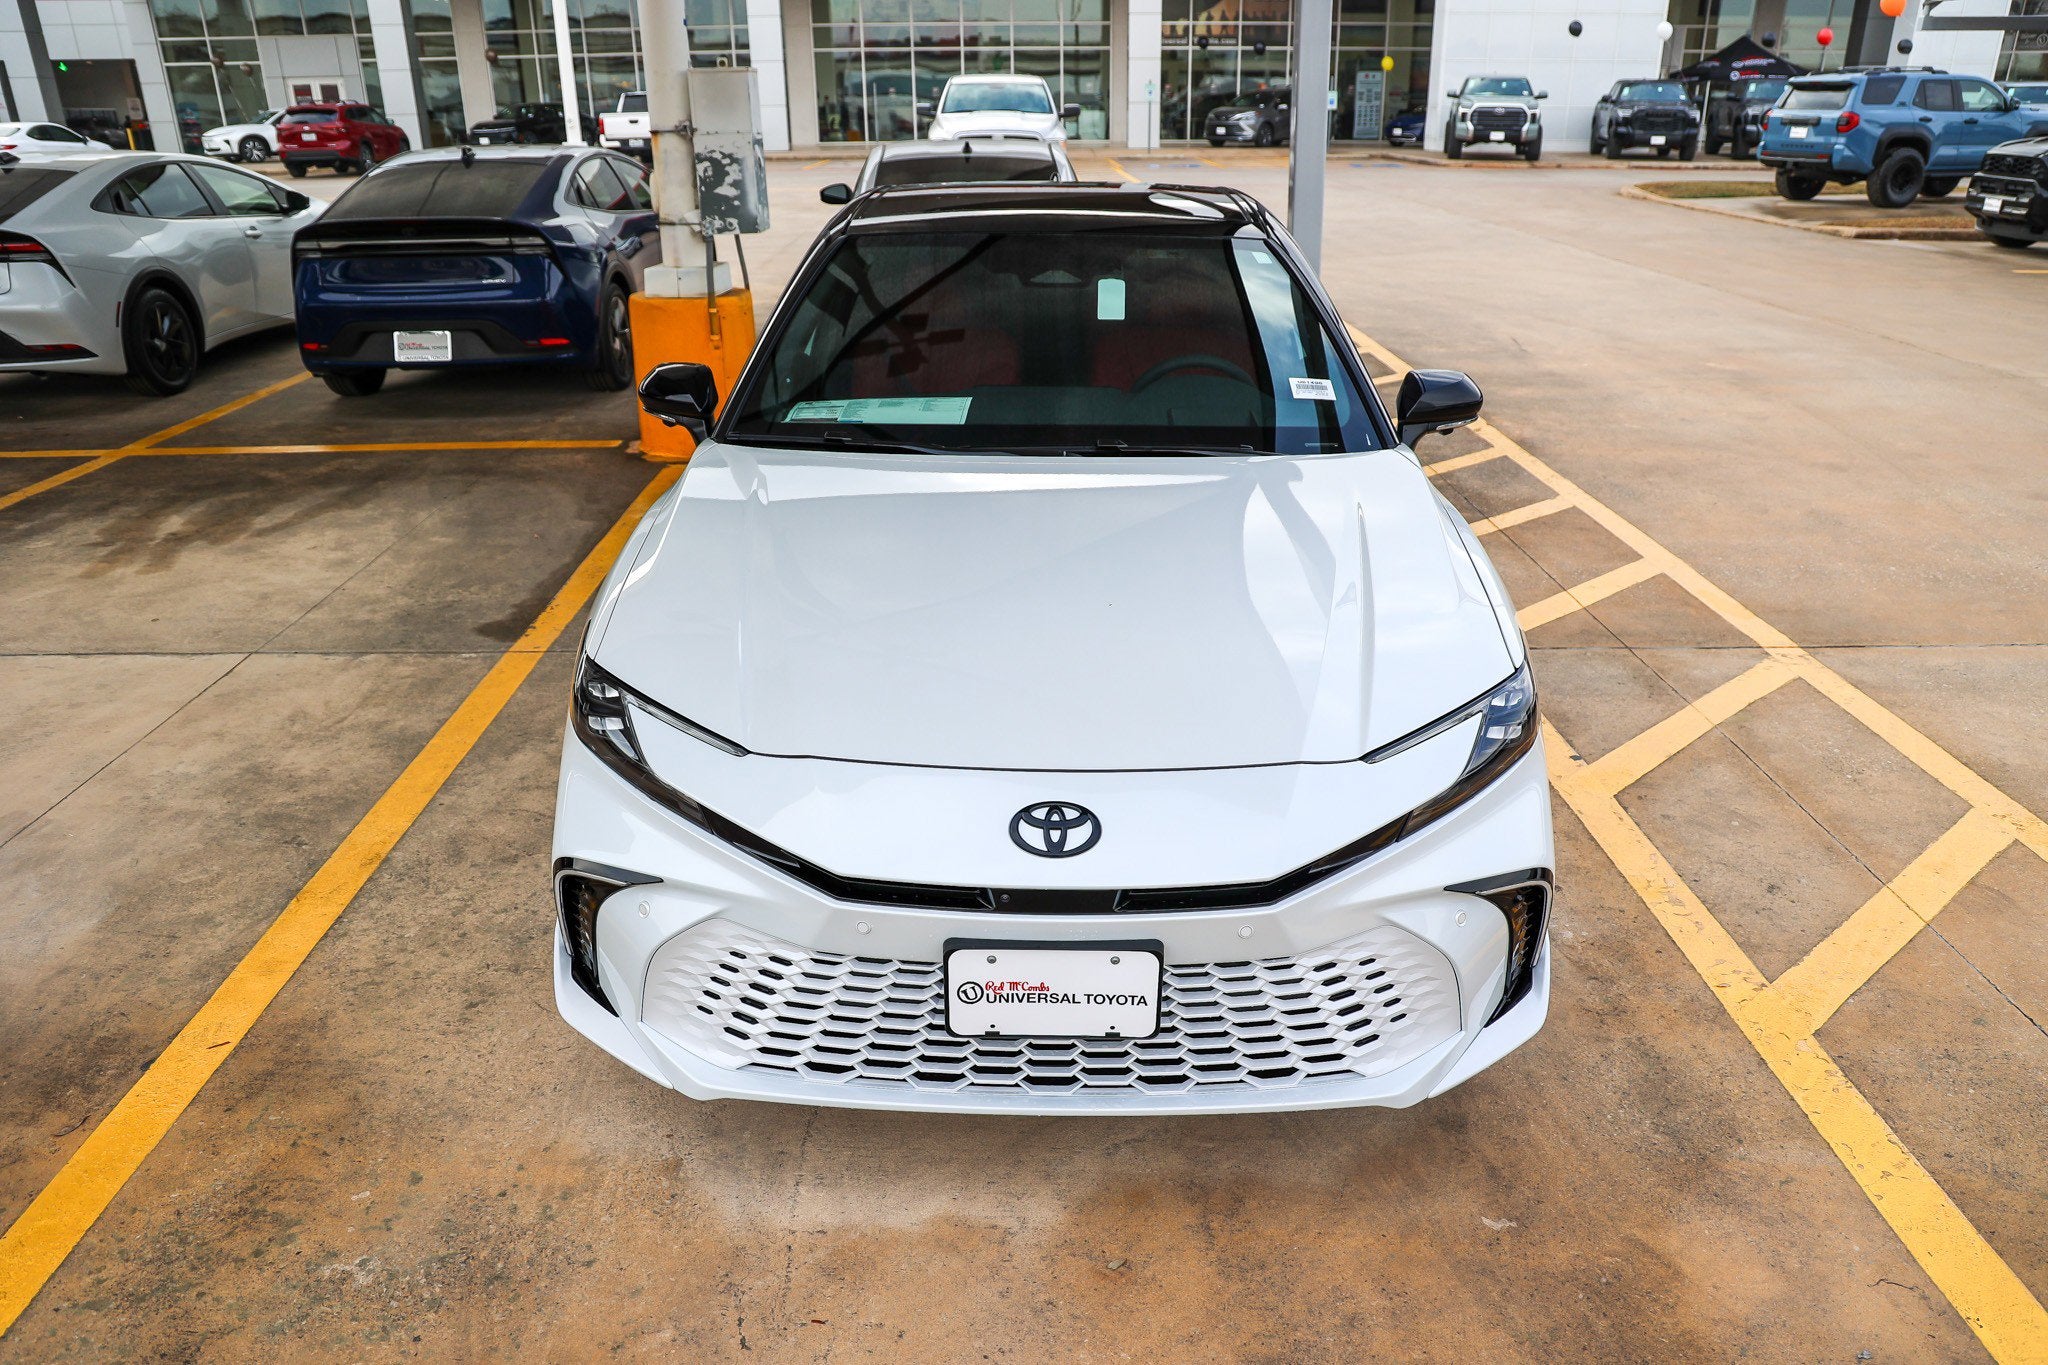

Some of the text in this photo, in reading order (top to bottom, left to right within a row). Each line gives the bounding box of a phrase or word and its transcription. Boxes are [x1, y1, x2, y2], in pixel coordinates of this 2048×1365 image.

[985, 981, 1050, 995] Red McCombs
[986, 992, 1148, 1006] UNIVERSAL TOYOTA
